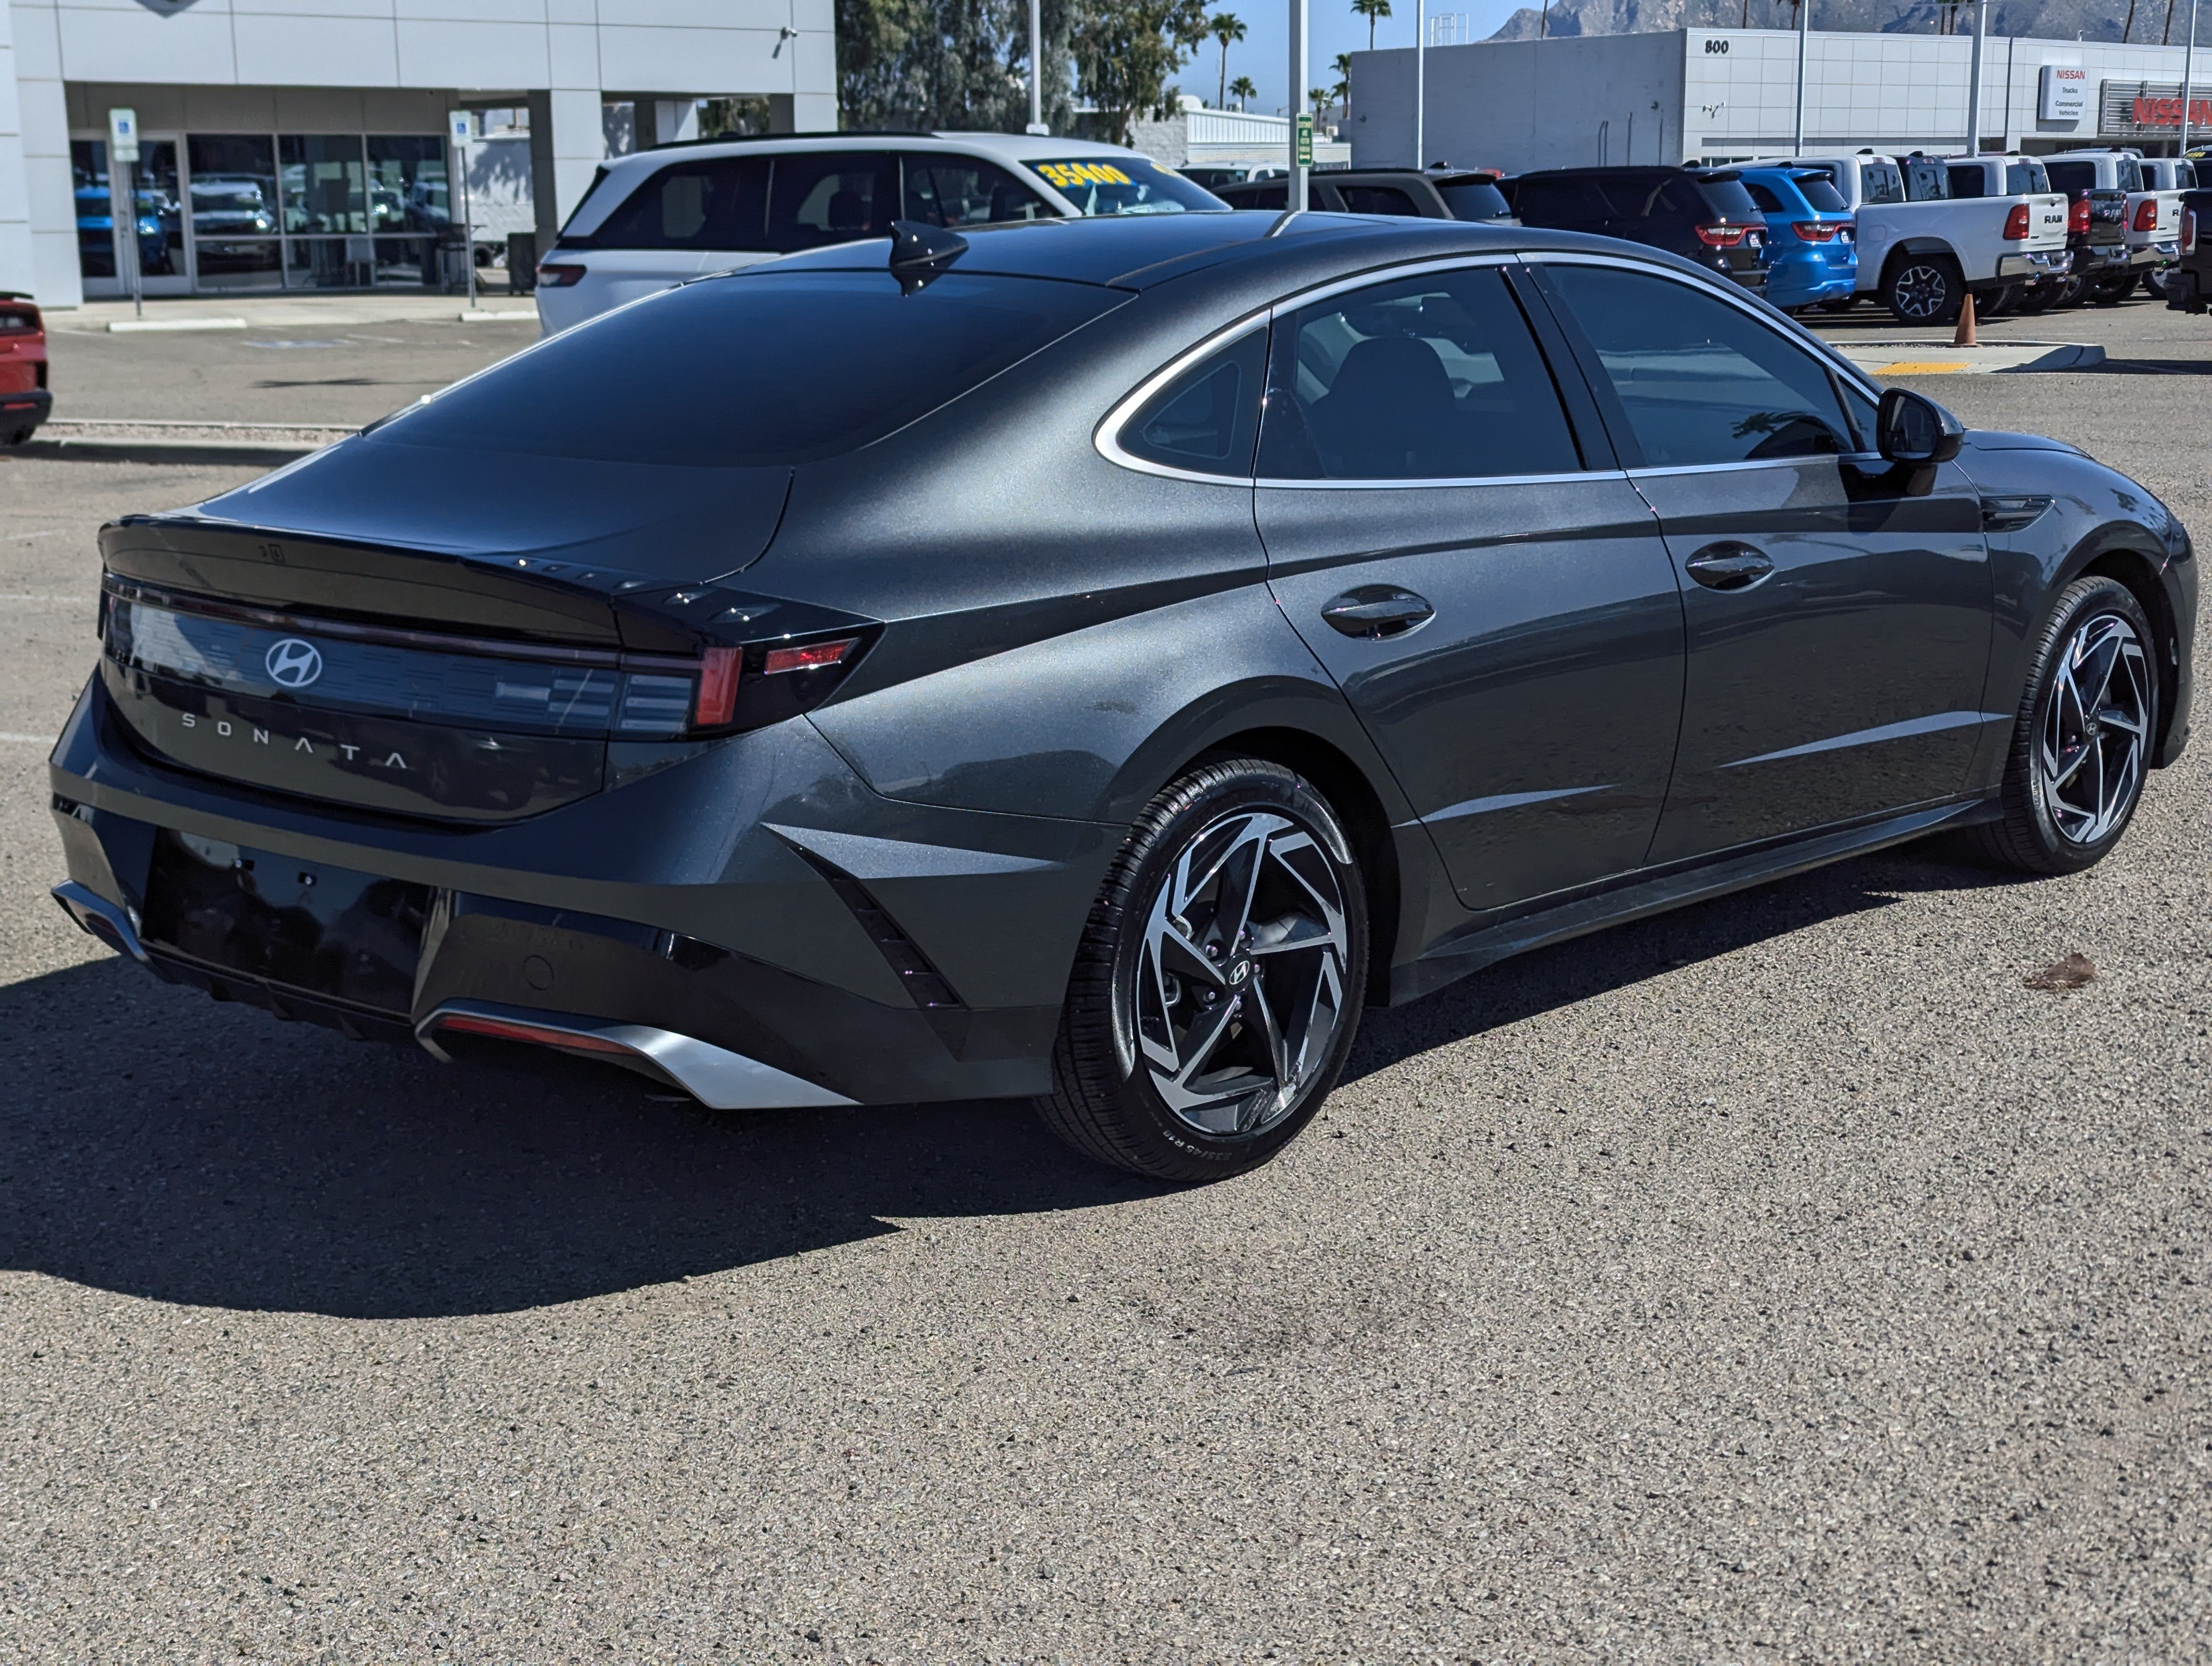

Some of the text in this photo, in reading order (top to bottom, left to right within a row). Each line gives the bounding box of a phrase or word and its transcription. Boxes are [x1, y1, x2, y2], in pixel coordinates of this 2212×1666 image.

[1705, 40, 1729, 54] 800
[2057, 70, 2086, 80] NISSAN
[2132, 97, 2212, 125] NISSAN
[2044, 215, 2062, 223] RAM
[182, 713, 407, 769] SONATA
